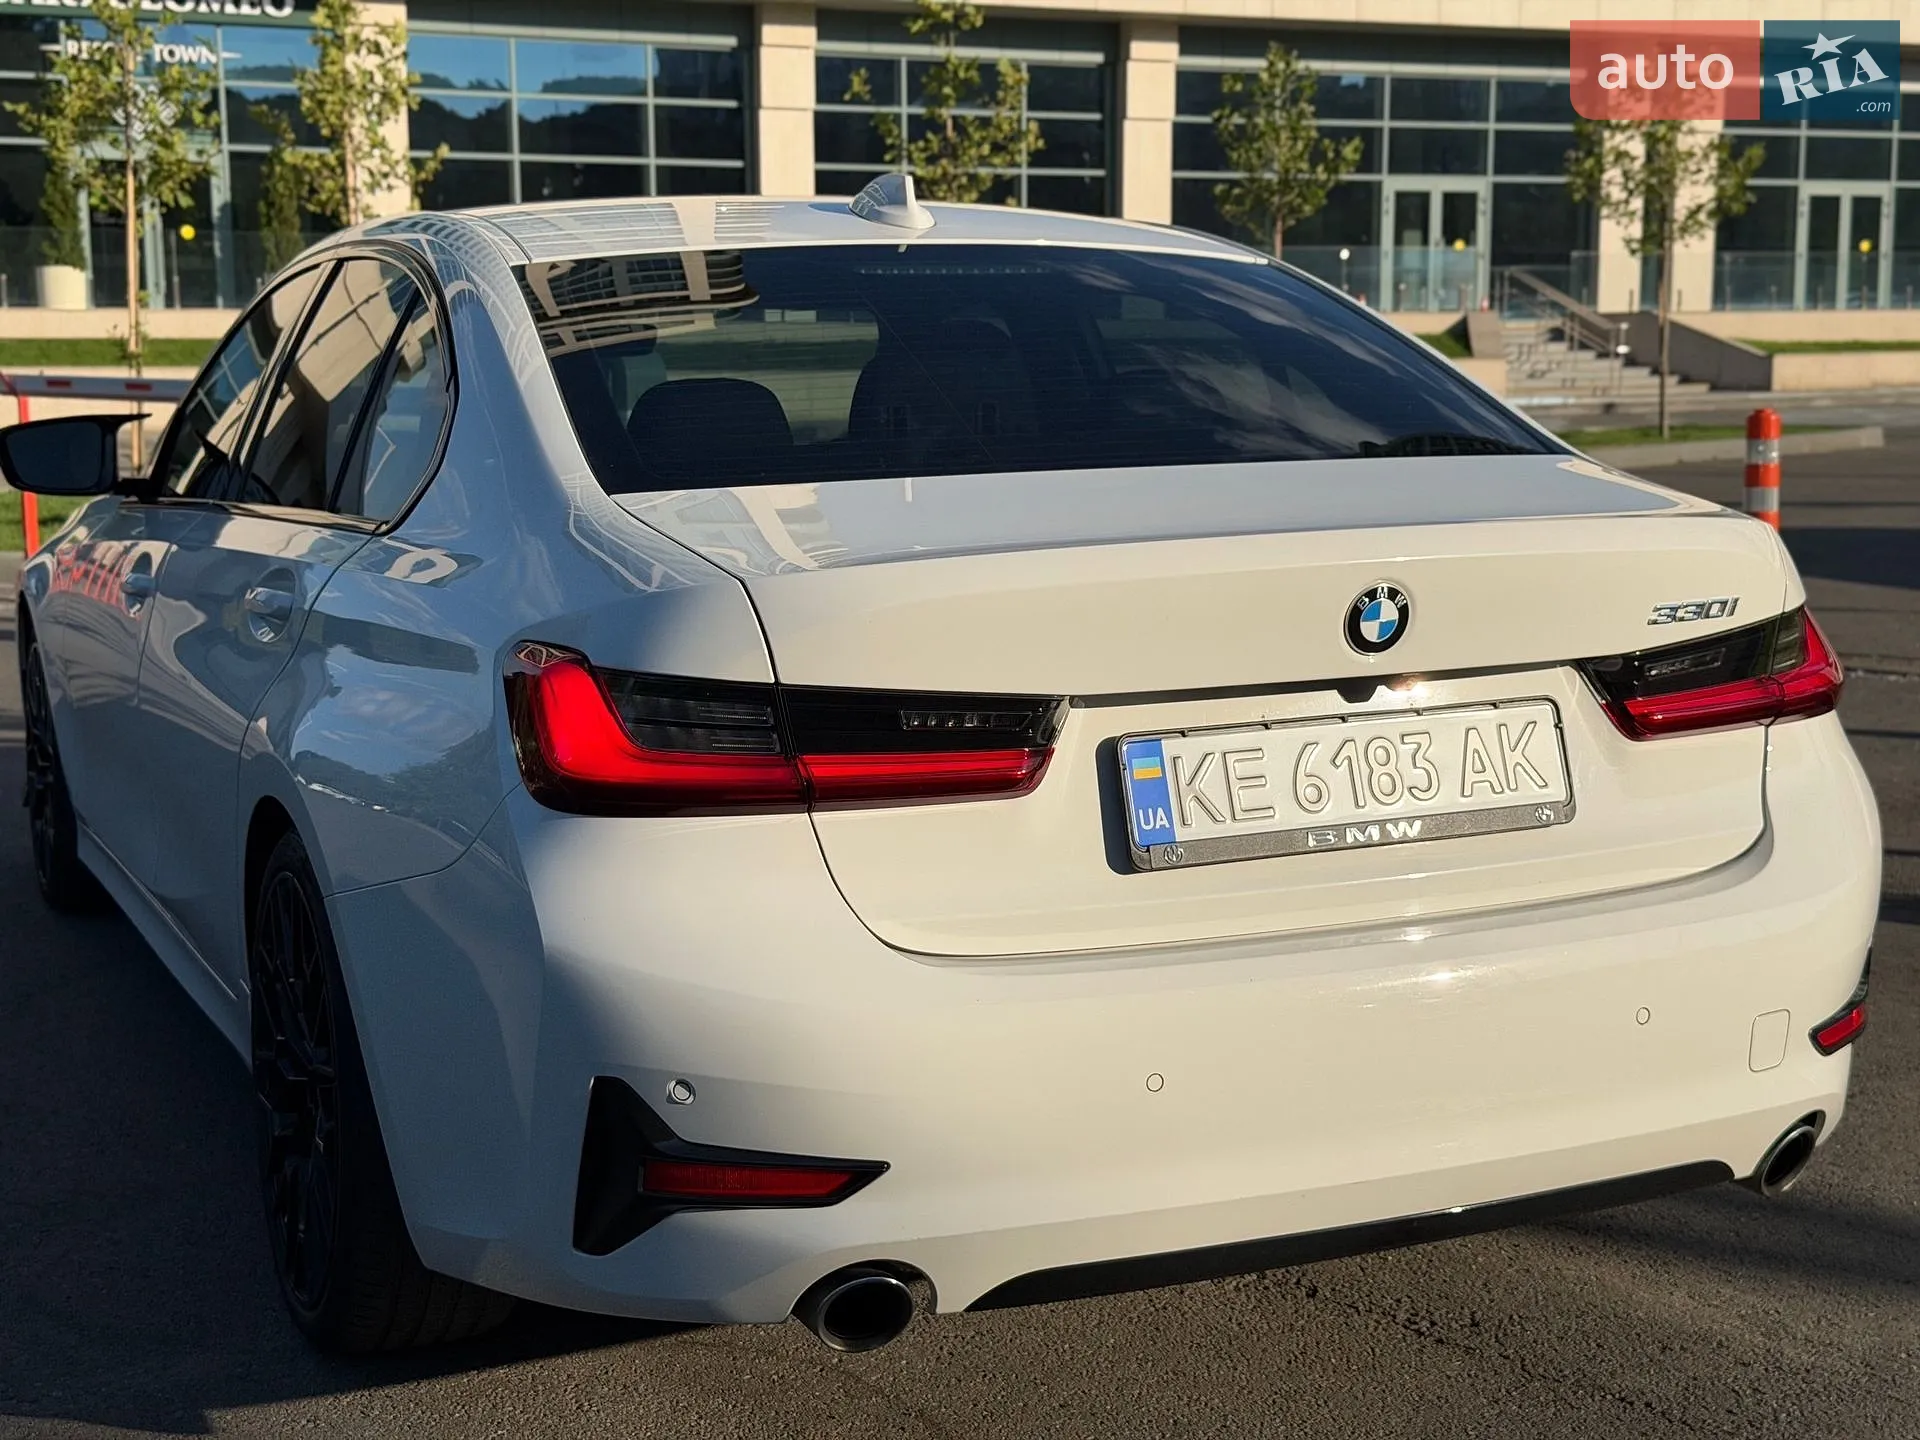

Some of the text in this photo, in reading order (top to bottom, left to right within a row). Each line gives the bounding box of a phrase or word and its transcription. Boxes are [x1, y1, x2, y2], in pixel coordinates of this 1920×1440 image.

[153, 43, 217, 64] TOWN
[1357, 586, 1407, 610] BMW
[1171, 720, 1548, 827] KE 6183 AK
[1139, 805, 1171, 831] UA
[1307, 819, 1422, 848] BMW
